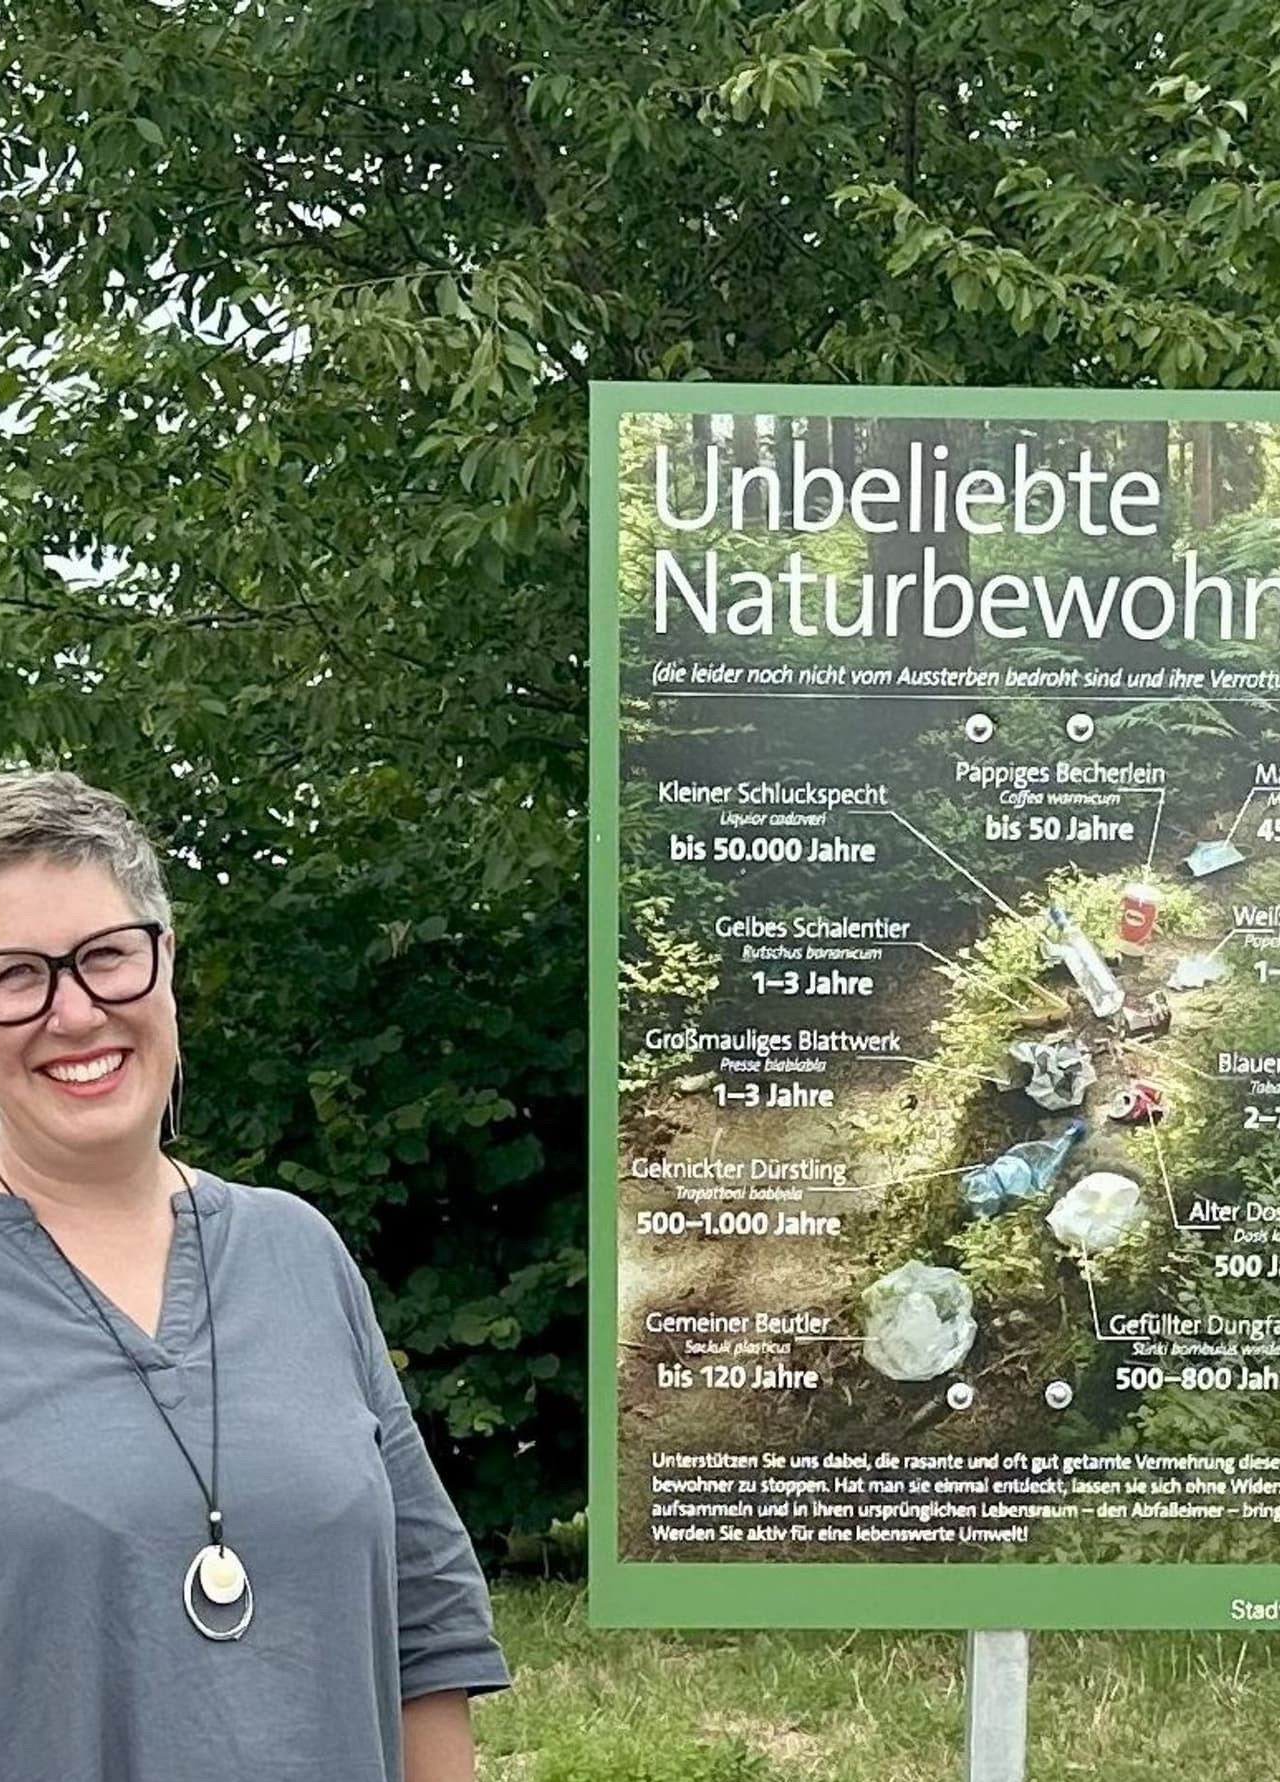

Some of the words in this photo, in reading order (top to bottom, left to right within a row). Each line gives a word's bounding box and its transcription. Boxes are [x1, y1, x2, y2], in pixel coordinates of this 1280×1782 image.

[653, 439, 1160, 536] Unbeliebte
[652, 662, 686, 686] (die
[691, 662, 744, 684] leider
[747, 664, 792, 684] noch
[799, 665, 846, 685] nicht
[851, 668, 892, 686] vom
[896, 666, 999, 687] Aussterben
[1005, 666, 1078, 687] bedroht
[1084, 668, 1123, 688] sind
[1128, 668, 1165, 689] und
[1169, 667, 1204, 689] ihre
[955, 761, 1049, 789] Pappiges
[1056, 761, 1165, 784] Becherlein
[658, 780, 732, 803] Kleiner
[738, 781, 889, 810] Schluckspecht
[986, 814, 1021, 841] bis
[1029, 816, 1061, 841] 50
[1066, 814, 1134, 841] Jahre
[670, 834, 706, 861] bis
[714, 837, 803, 862] 50.000
[807, 836, 876, 862] Jahre
[715, 915, 787, 938] Gelbes
[793, 916, 910, 939] Schalentier
[752, 970, 800, 995] 1–3
[805, 969, 874, 995] Jahre
[645, 1028, 792, 1057] Großmauliges
[798, 1029, 901, 1051] Blattwerk
[713, 1083, 760, 1107] 1–3
[766, 1081, 834, 1107] Jahre
[632, 1157, 745, 1180] Geknickter
[750, 1159, 847, 1186] Dürstling
[637, 1211, 769, 1235] 500–1.000
[773, 1210, 841, 1236] Jahre
[1189, 1200, 1241, 1221] Alter
[1215, 1254, 1262, 1278] 500
[646, 1311, 749, 1333] Gemeiner
[755, 1312, 831, 1334] Beutler
[1109, 1312, 1201, 1335] Gefüllter
[657, 1362, 693, 1388] bis
[700, 1365, 746, 1389] 120
[751, 1363, 819, 1389] Jahre
[1116, 1367, 1232, 1390] 500–800
[652, 1452, 758, 1468] Unterstützen
[762, 1453, 786, 1469] Sie
[790, 1456, 819, 1468] uns
[823, 1453, 871, 1471] dabei,
[875, 1453, 900, 1469] die
[904, 1455, 963, 1469] rasante
[967, 1453, 999, 1469] und
[1003, 1453, 1028, 1469] oft
[1031, 1454, 1059, 1474] gut
[1063, 1455, 1132, 1474] getarnte
[1135, 1454, 1235, 1474] Vermehrung
[652, 1476, 734, 1493] bewohner
[738, 1480, 756, 1493] zu
[760, 1479, 830, 1497] stoppen.
[834, 1477, 864, 1493] Hat
[868, 1480, 904, 1493] man
[908, 1478, 930, 1494] sie
[934, 1477, 988, 1493] einmal
[992, 1478, 1068, 1497] entdeckt,
[1072, 1478, 1121, 1494] lassen
[1125, 1478, 1146, 1494] sie
[1150, 1478, 1181, 1494] sich
[1185, 1478, 1226, 1494] ohne
[651, 1501, 753, 1517] aufsammeln
[757, 1501, 788, 1517] und
[792, 1501, 807, 1517] in
[812, 1501, 854, 1517] ihren
[858, 1501, 976, 1522] ursprünglichen
[981, 1502, 1078, 1518] Lebensraum
[1097, 1502, 1127, 1518] den
[1131, 1502, 1224, 1518] Abfalleimer
[651, 1525, 715, 1541] Werden
[719, 1525, 743, 1541] Sie
[746, 1525, 787, 1541] aktiv
[791, 1525, 814, 1541] für
[817, 1525, 852, 1541] eine
[856, 1525, 955, 1541] lebenswerte
[959, 1526, 1029, 1542] Umwelt!
